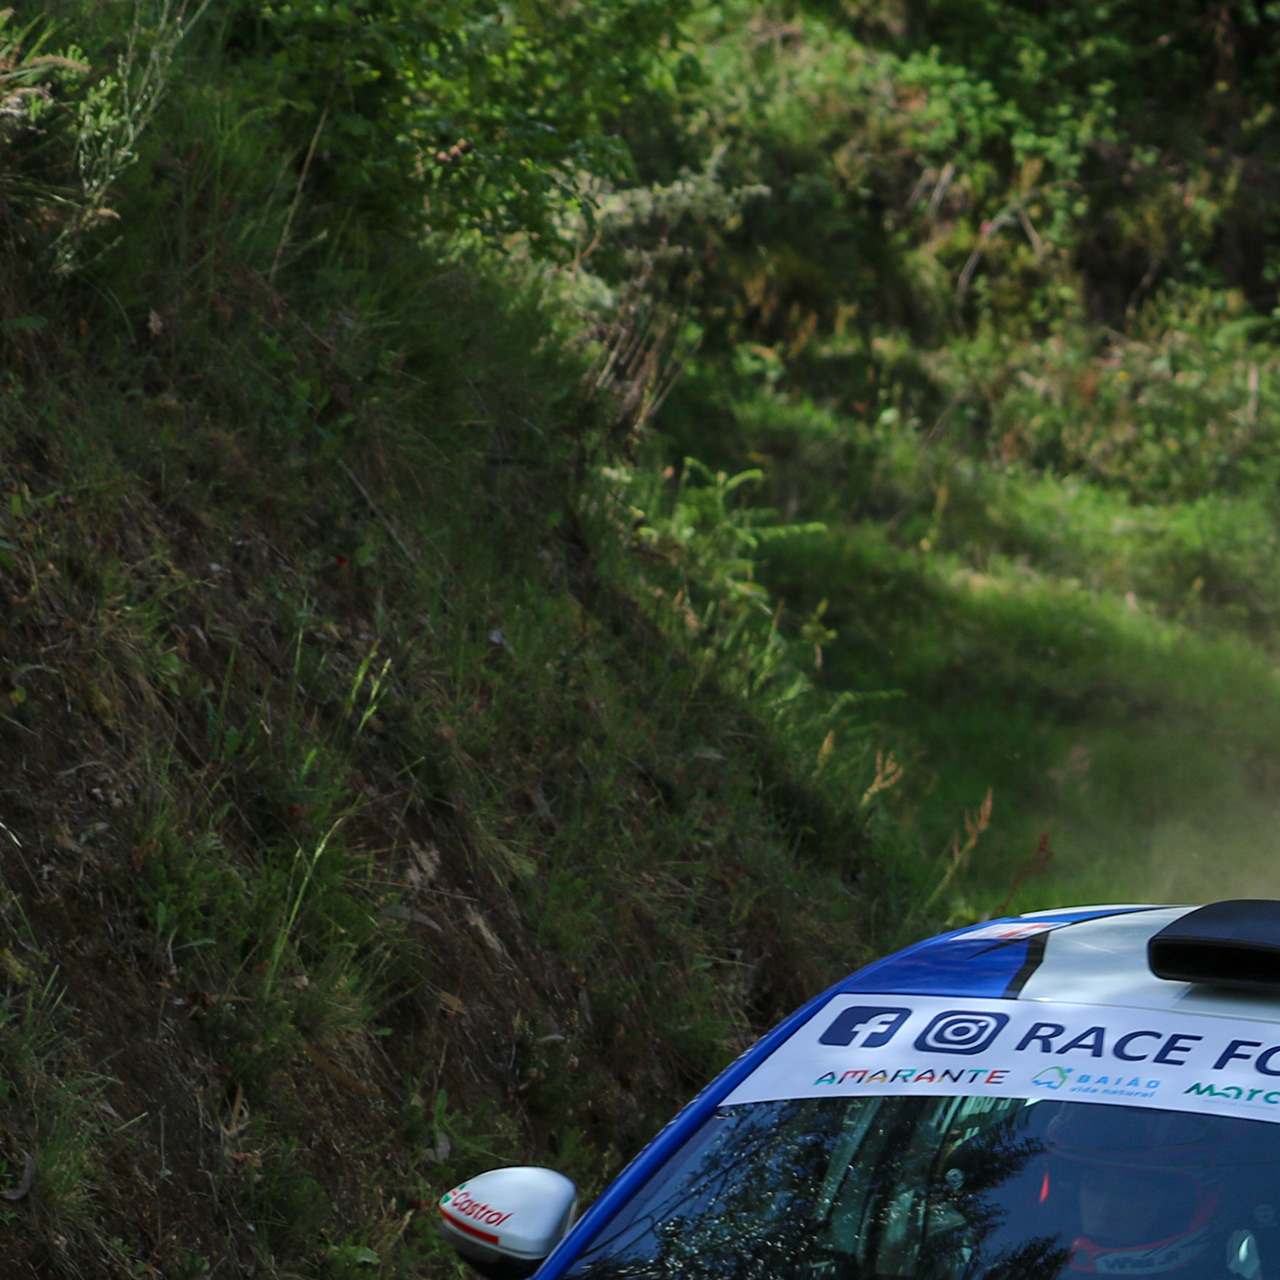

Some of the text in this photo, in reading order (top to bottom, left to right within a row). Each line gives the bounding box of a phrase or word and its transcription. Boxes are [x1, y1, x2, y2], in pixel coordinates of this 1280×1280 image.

[1015, 1021, 1202, 1066] RACE
[813, 1068, 1011, 1086] AMARANTE
[1076, 1074, 1162, 1089] BAIÃO
[452, 1191, 515, 1227] Castrol
